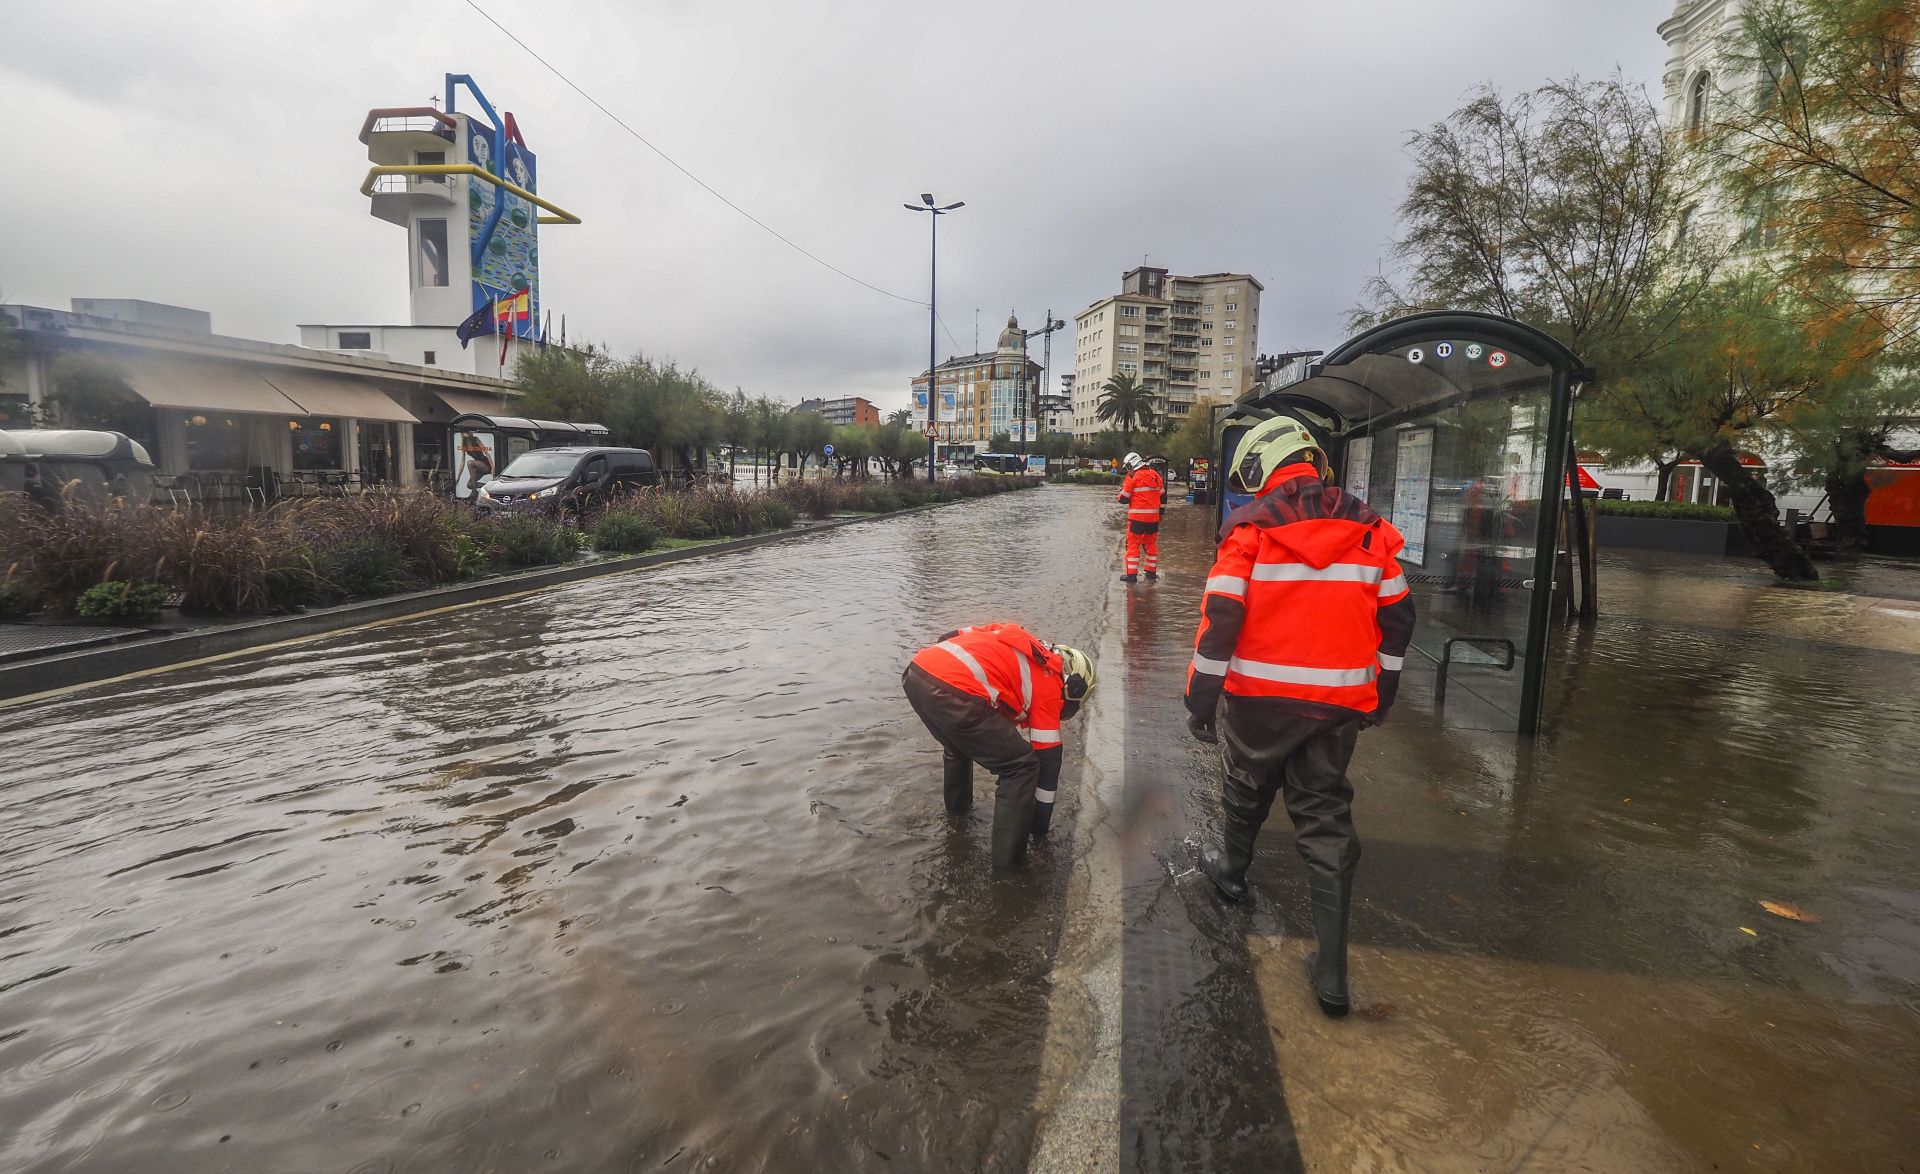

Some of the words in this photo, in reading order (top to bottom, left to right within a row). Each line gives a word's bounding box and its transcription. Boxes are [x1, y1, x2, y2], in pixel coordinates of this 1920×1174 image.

[1439, 346, 1450, 354] 11
[1467, 347, 1481, 355] N-2
[1413, 352, 1420, 360] 5
